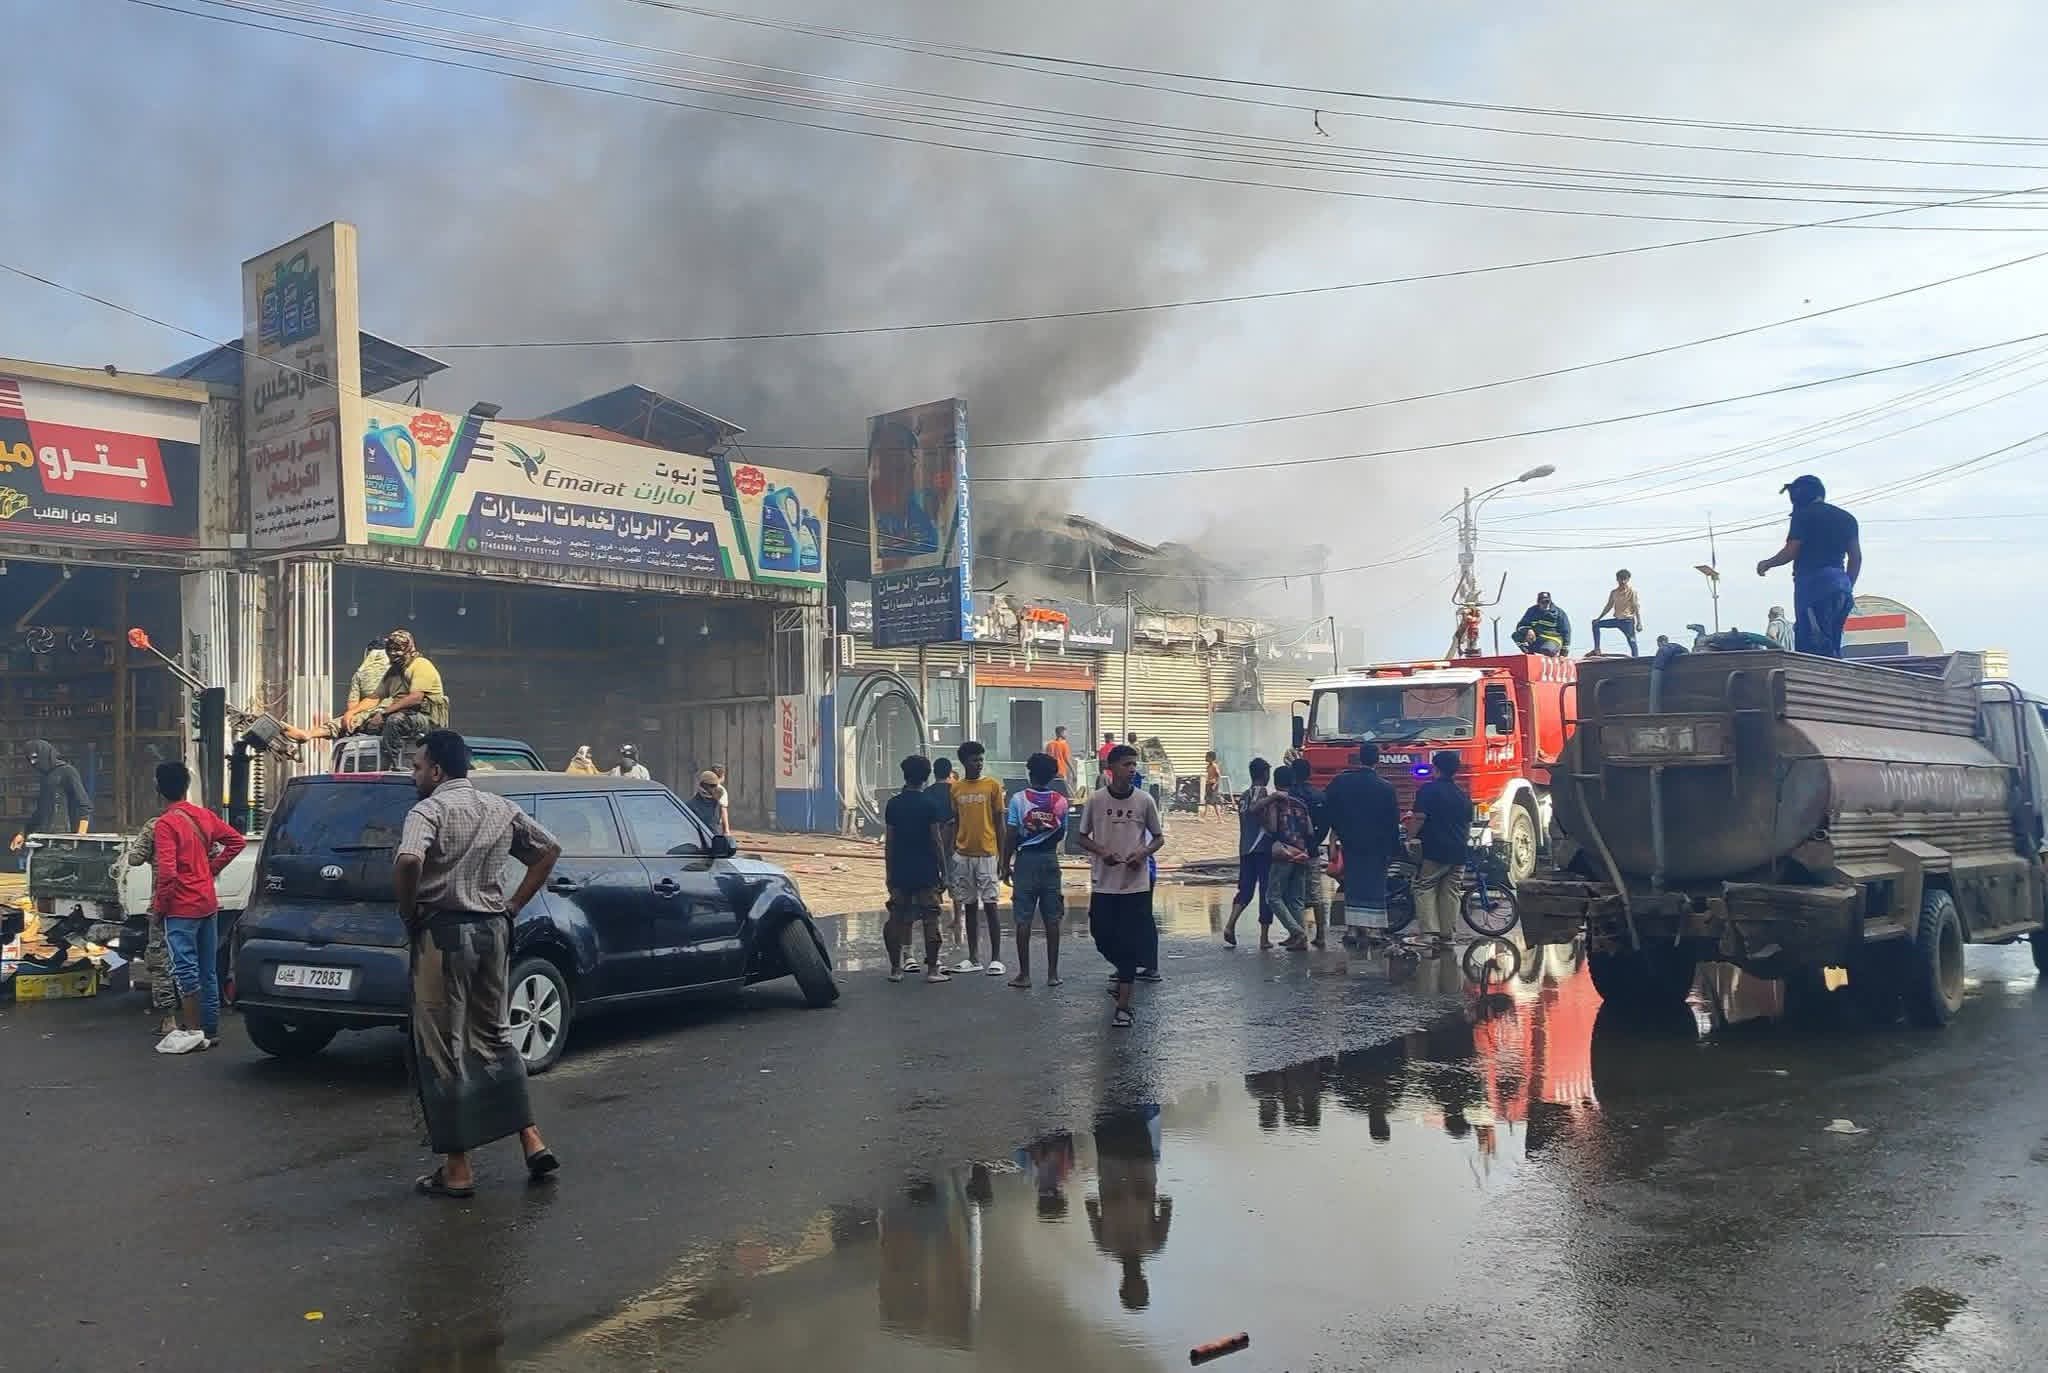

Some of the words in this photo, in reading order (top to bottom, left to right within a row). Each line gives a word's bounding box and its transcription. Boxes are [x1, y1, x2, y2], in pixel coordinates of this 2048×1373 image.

[39, 443, 148, 488] بترو
[655, 461, 697, 486] زيوت
[543, 469, 627, 498] Emarat
[33, 506, 68, 520] القلب
[72, 508, 91, 523] من
[479, 495, 551, 527] السيارات
[552, 505, 616, 531] لخدمات
[616, 514, 663, 539] الريان
[664, 522, 709, 547] مركز
[878, 575, 914, 597] الريان
[915, 568, 953, 592] مركز
[880, 595, 917, 612] السيارات
[917, 591, 951, 608] لخدمات
[781, 697, 793, 777] LUBEX
[322, 867, 342, 878] KIA
[309, 969, 344, 986] 72883
